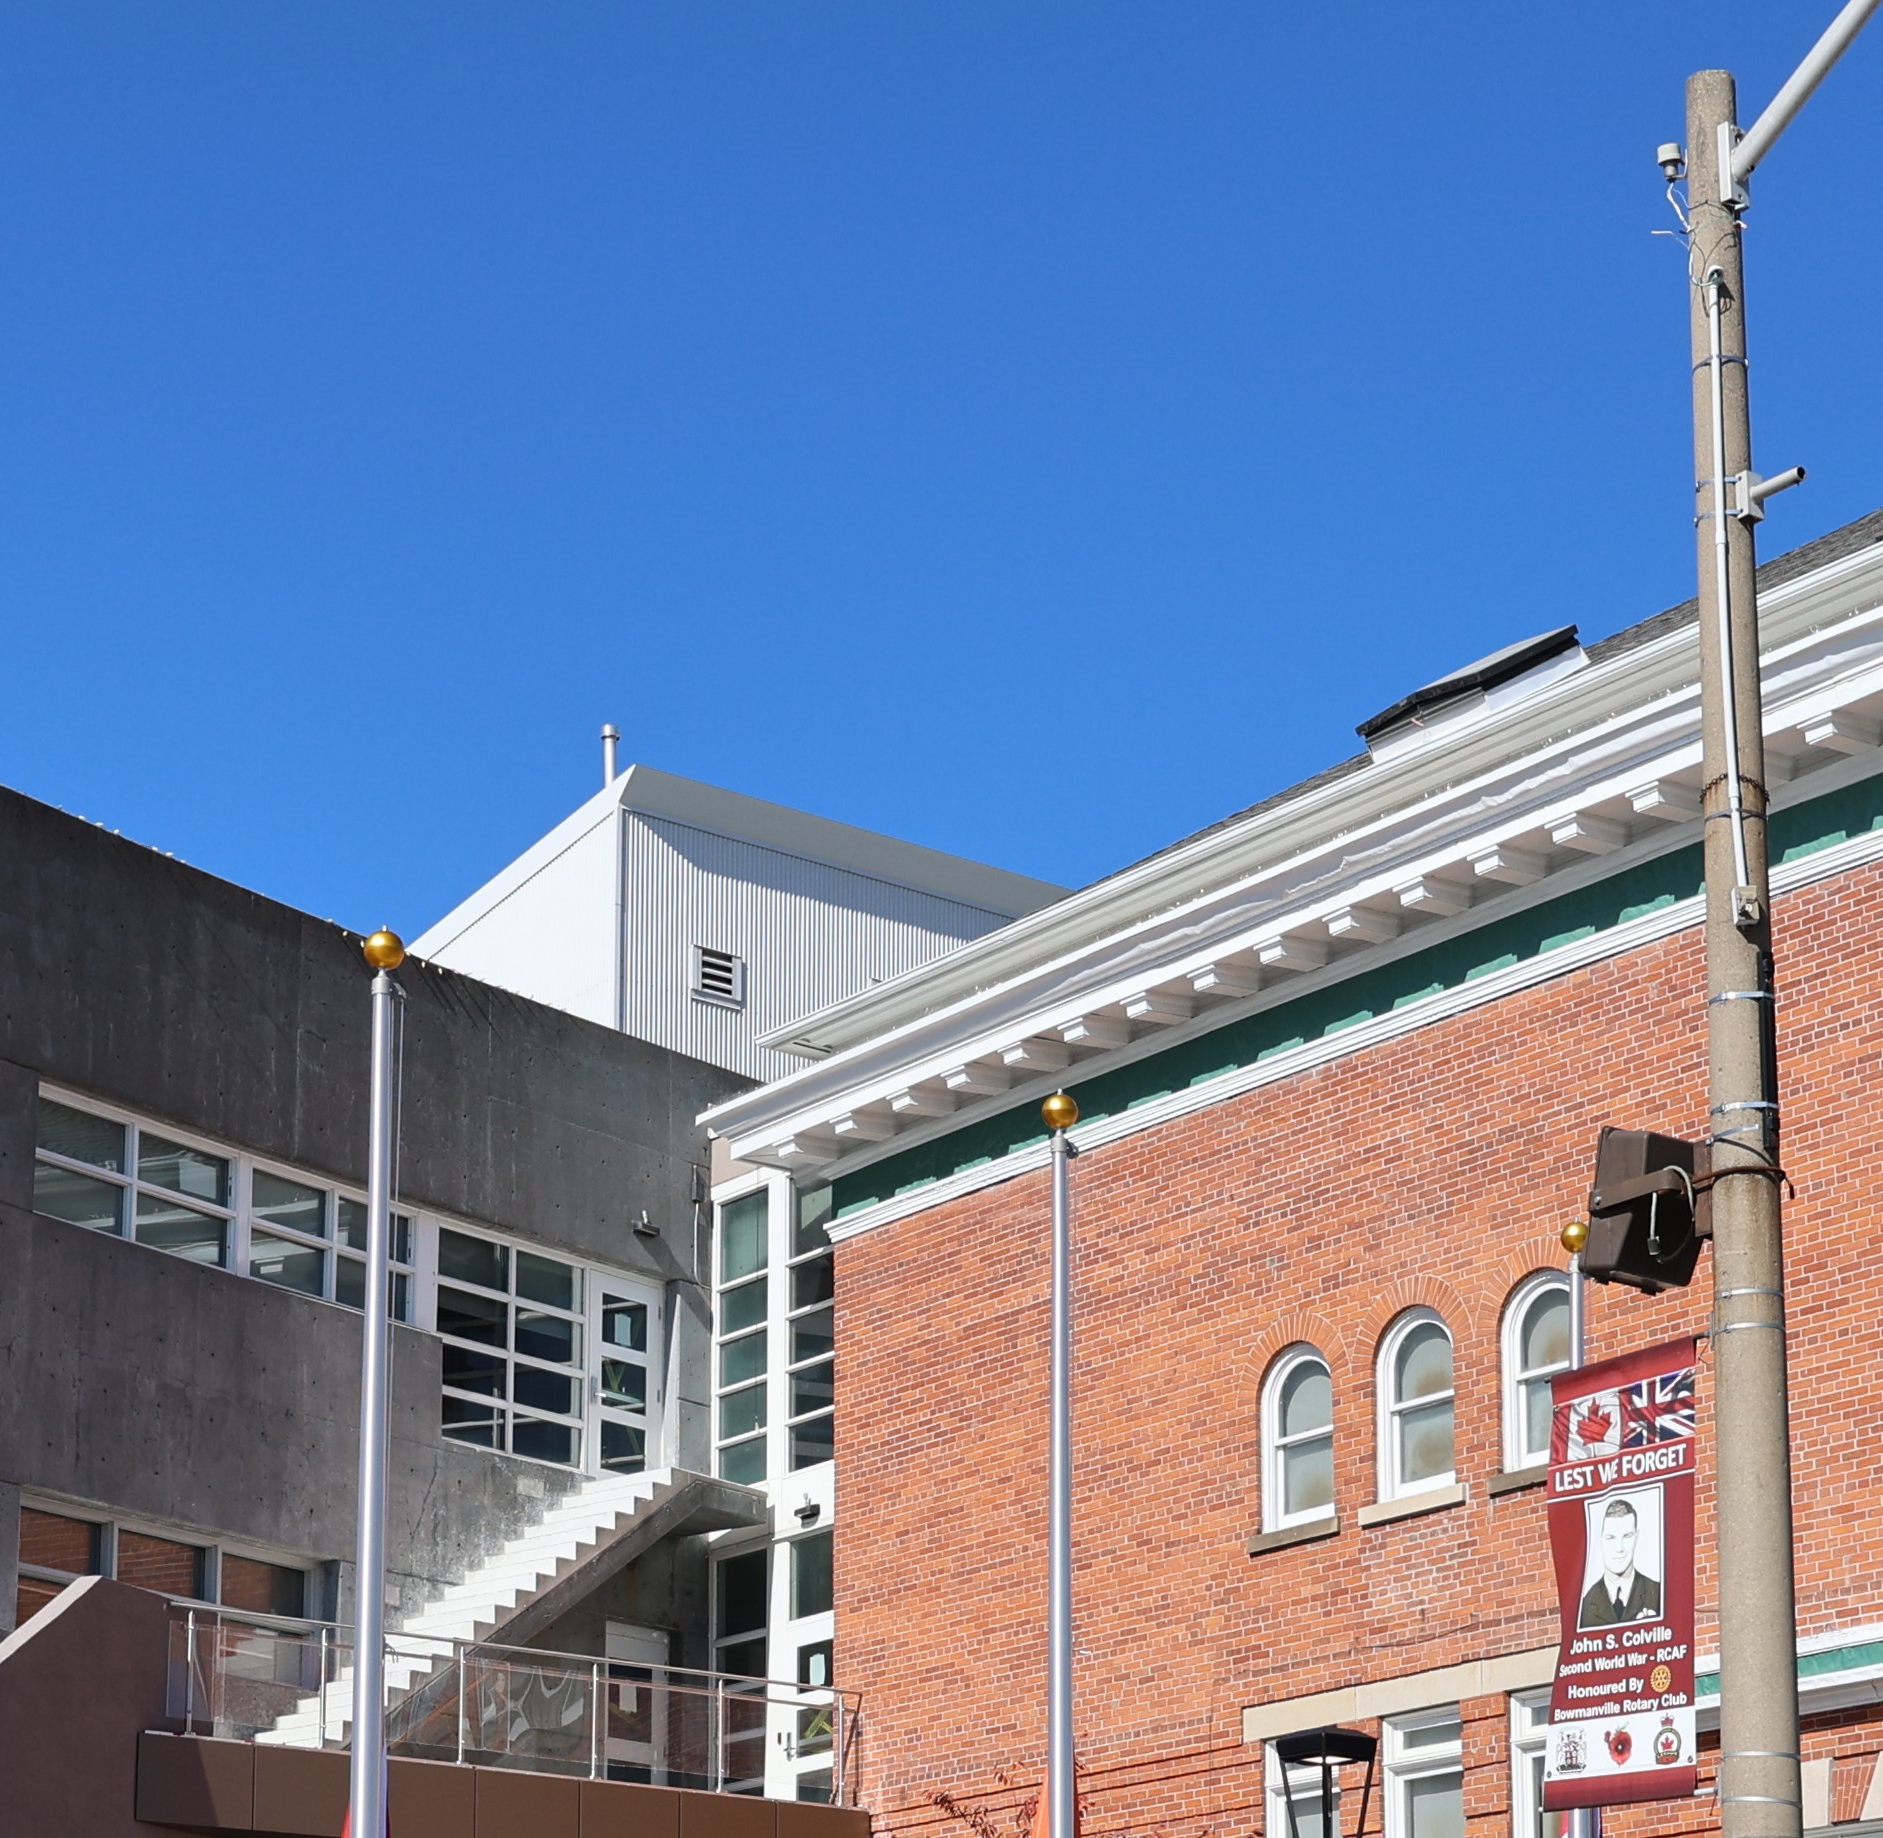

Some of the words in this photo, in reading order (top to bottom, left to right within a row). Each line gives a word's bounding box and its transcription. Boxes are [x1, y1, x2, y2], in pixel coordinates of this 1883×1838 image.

[1555, 1466, 1594, 1492] LEST
[1598, 1459, 1619, 1484] WE
[1622, 1443, 1687, 1477] FORGET
[1570, 1638, 1602, 1655] John
[1605, 1634, 1619, 1649] S.
[1622, 1626, 1672, 1647] Colville
[1559, 1660, 1592, 1677] Second
[1594, 1655, 1626, 1671] World
[1627, 1652, 1647, 1667] War
[1656, 1645, 1688, 1662] RCAF
[1568, 1679, 1626, 1699] Honoured
[1629, 1677, 1644, 1693] By
[1554, 1702, 1621, 1721] Bowmanville
[1623, 1697, 1660, 1712] Rotary
[1661, 1692, 1688, 1707] Club
